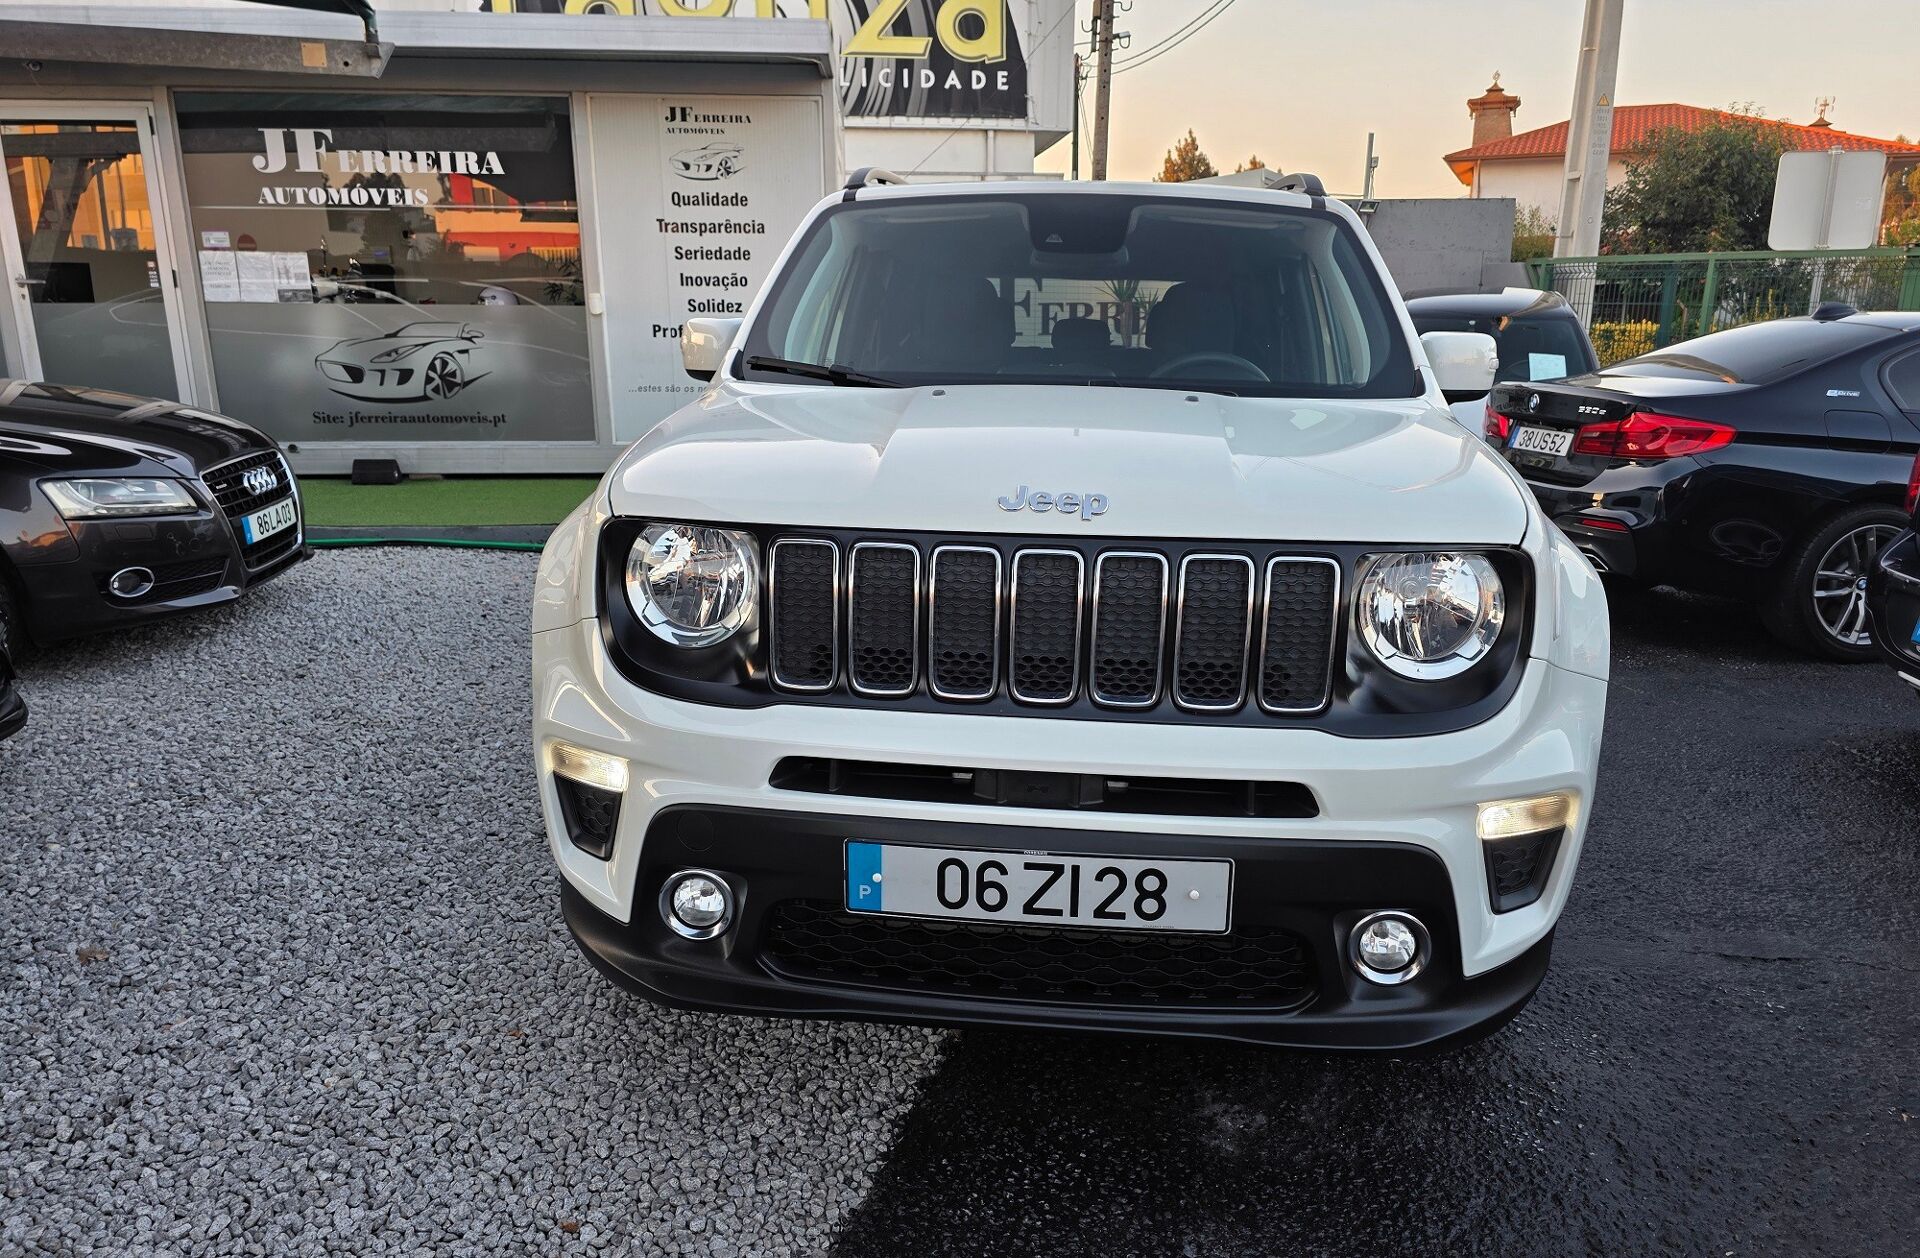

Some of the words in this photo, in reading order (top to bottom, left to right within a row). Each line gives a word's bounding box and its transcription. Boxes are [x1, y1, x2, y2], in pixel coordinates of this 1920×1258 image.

[258, 183, 429, 207] AUTOMÓVEIS
[671, 191, 749, 207] Qualidade
[656, 218, 766, 237] Transparência
[674, 245, 751, 261] Seriedade
[679, 272, 748, 291] Inovação
[687, 298, 743, 313] Solidez
[664, 384, 681, 393] são
[312, 411, 345, 425] Site:
[348, 411, 507, 428] jferreiraautomoveis.pt
[997, 484, 1110, 521] Jeep
[859, 884, 872, 900] P
